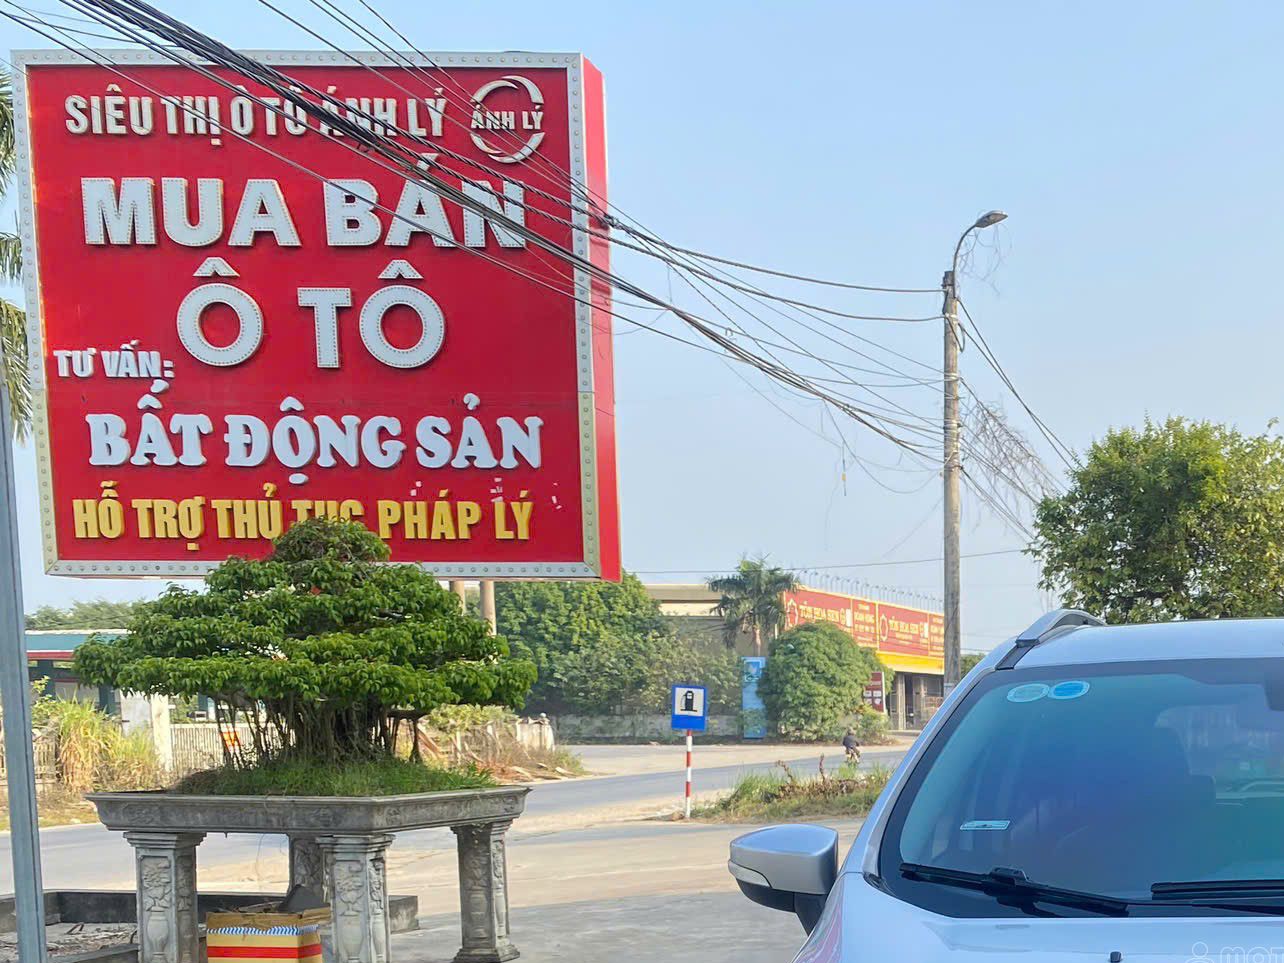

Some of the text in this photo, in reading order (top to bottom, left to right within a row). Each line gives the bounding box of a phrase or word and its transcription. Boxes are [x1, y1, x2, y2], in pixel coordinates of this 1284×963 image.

[65, 84, 447, 146] SIÊU THỊ Ô TÔ ÁNH LÝ
[470, 104, 544, 130] ÁNH LÝ
[81, 152, 527, 248] MUA BÁN
[176, 257, 445, 369] Ô TÔ
[53, 339, 175, 379] TƯ VẤN:
[85, 379, 543, 485] BẤT ĐỘNG SẢN
[72, 480, 124, 539] HỖ
[131, 495, 206, 551] TRỢ
[211, 482, 284, 540] THỦ
[377, 489, 482, 540] PHÁP
[491, 490, 534, 541] LÝ
